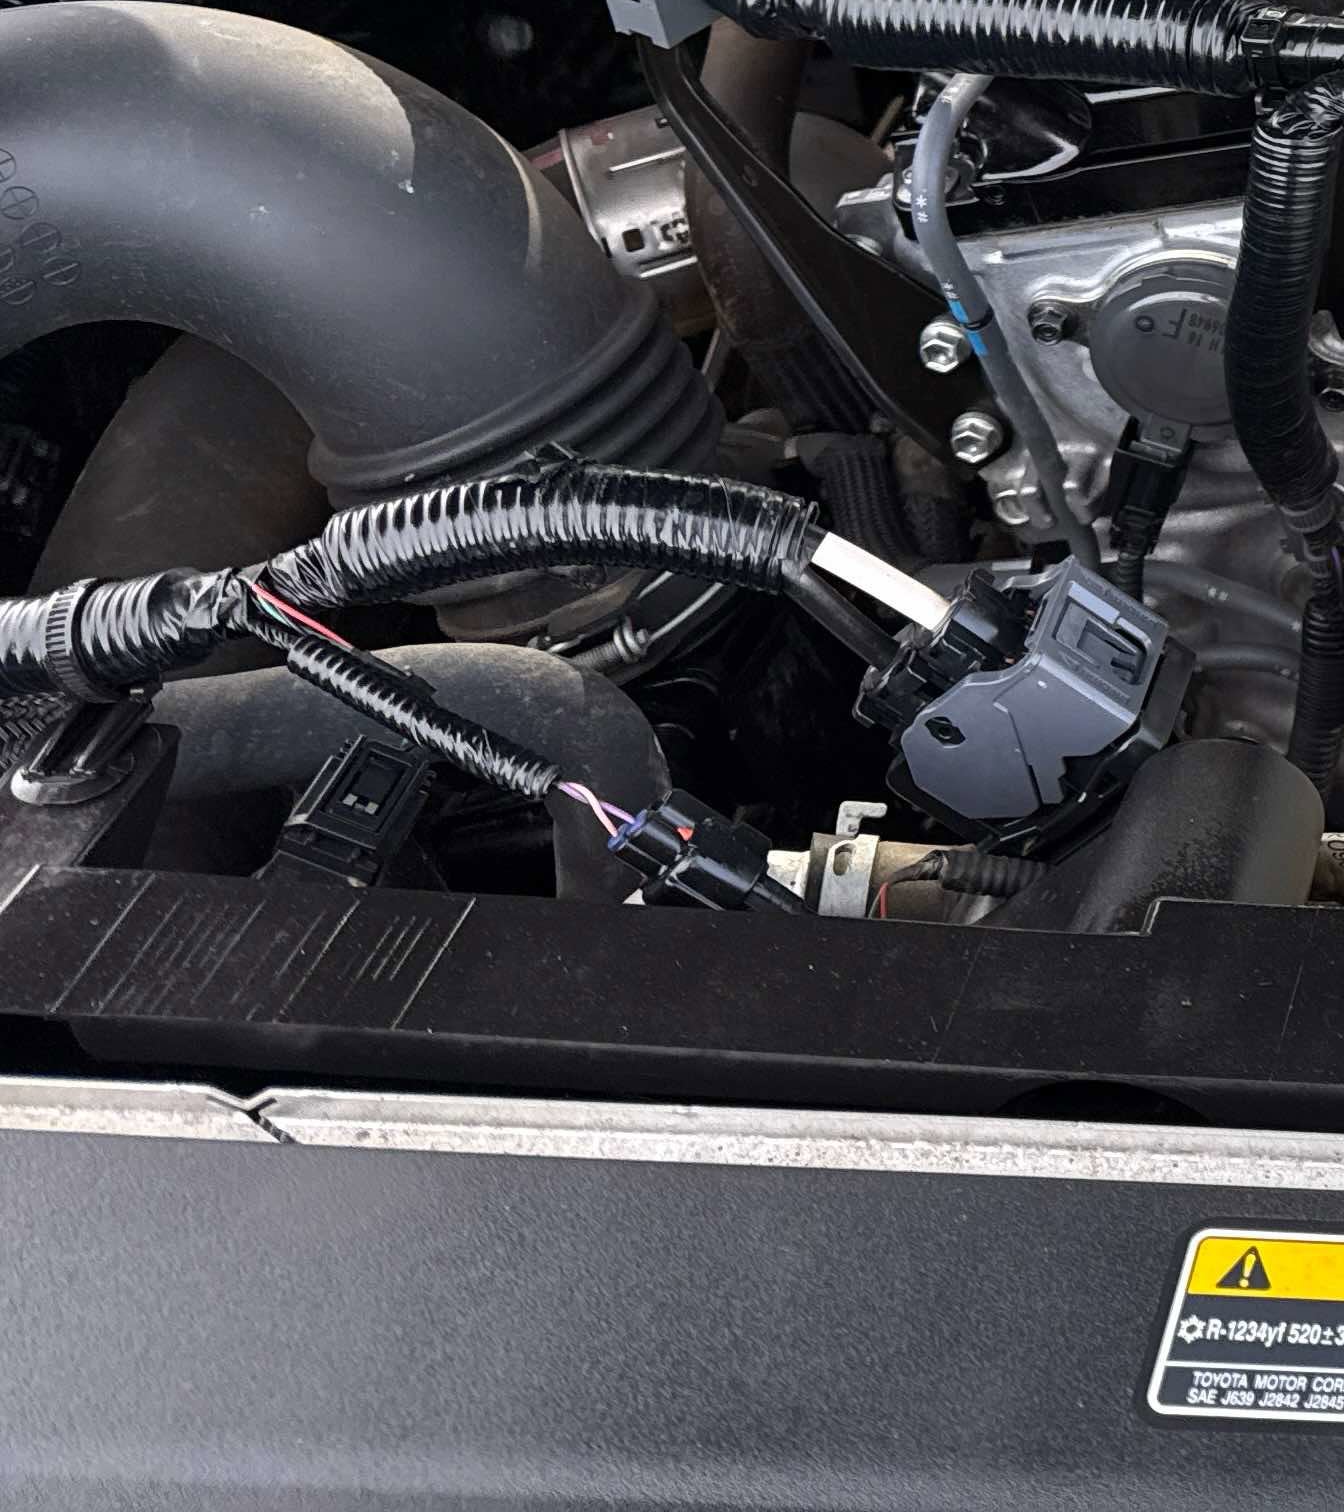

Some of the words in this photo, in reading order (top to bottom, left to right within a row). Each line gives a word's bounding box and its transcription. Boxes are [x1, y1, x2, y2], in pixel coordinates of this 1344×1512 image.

[1206, 1318, 1287, 1348] R-1234yf
[1192, 1370, 1249, 1388] TOYOTA
[1254, 1374, 1306, 1391] MOTOR
[1186, 1388, 1218, 1404] SAE
[1220, 1391, 1255, 1406] J639
